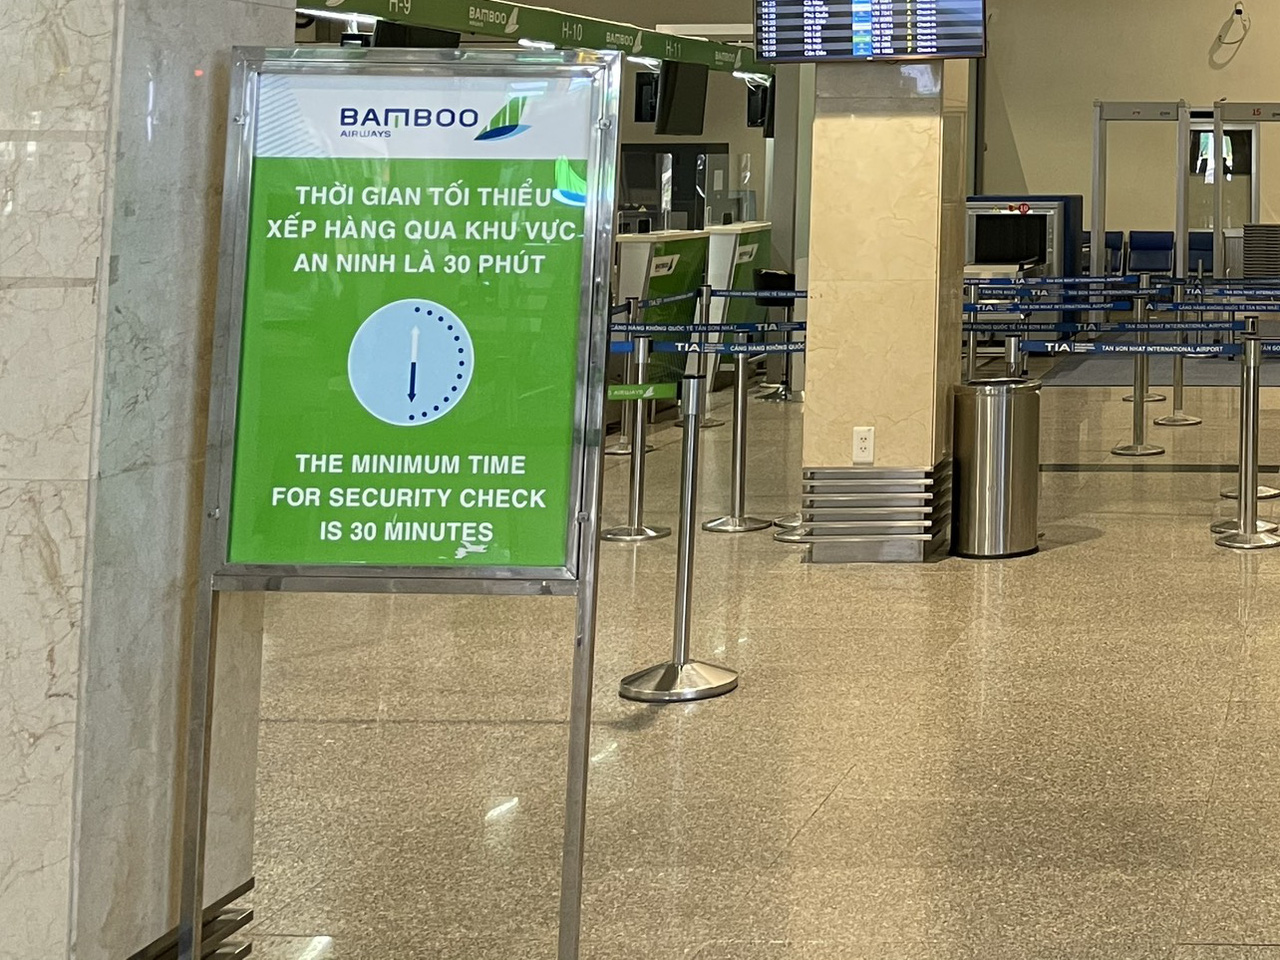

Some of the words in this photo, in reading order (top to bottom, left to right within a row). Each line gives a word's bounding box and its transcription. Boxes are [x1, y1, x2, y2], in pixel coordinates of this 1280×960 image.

[469, 6, 507, 25] BAMBOO
[561, 22, 583, 41] H-10
[665, 40, 682, 57] H-11
[340, 108, 479, 129] BAMBOO
[1252, 108, 1261, 116] 15
[340, 130, 391, 138] AIRWAYS
[296, 181, 354, 206] THỜI
[362, 188, 421, 207] GIAN
[428, 179, 470, 207] TỐI
[478, 178, 552, 208] THIỂU
[266, 212, 317, 239] XẾP
[324, 216, 396, 241] HÀNG
[404, 220, 458, 243] QUA
[465, 220, 517, 242] KHU
[524, 220, 577, 245] VỰC
[293, 253, 329, 273] AN
[336, 253, 396, 274] NINH
[403, 251, 436, 274] LÀ
[443, 254, 471, 274] 30
[479, 251, 546, 275] PHÚT
[675, 342, 700, 352] TIA
[730, 344, 747, 352] CẢNG
[748, 344, 764, 352] HÀNG
[766, 344, 786, 352] KHÔNG
[1044, 342, 1070, 352] TIA
[295, 453, 344, 474] THE
[351, 454, 460, 475] MINIMUM
[467, 454, 527, 475] TIME
[271, 487, 321, 507] FOR
[328, 487, 452, 508] SECURITY
[459, 487, 547, 509] CHECK
[319, 521, 343, 541] IS
[349, 521, 377, 542] 30
[384, 521, 494, 543] MINUTES
